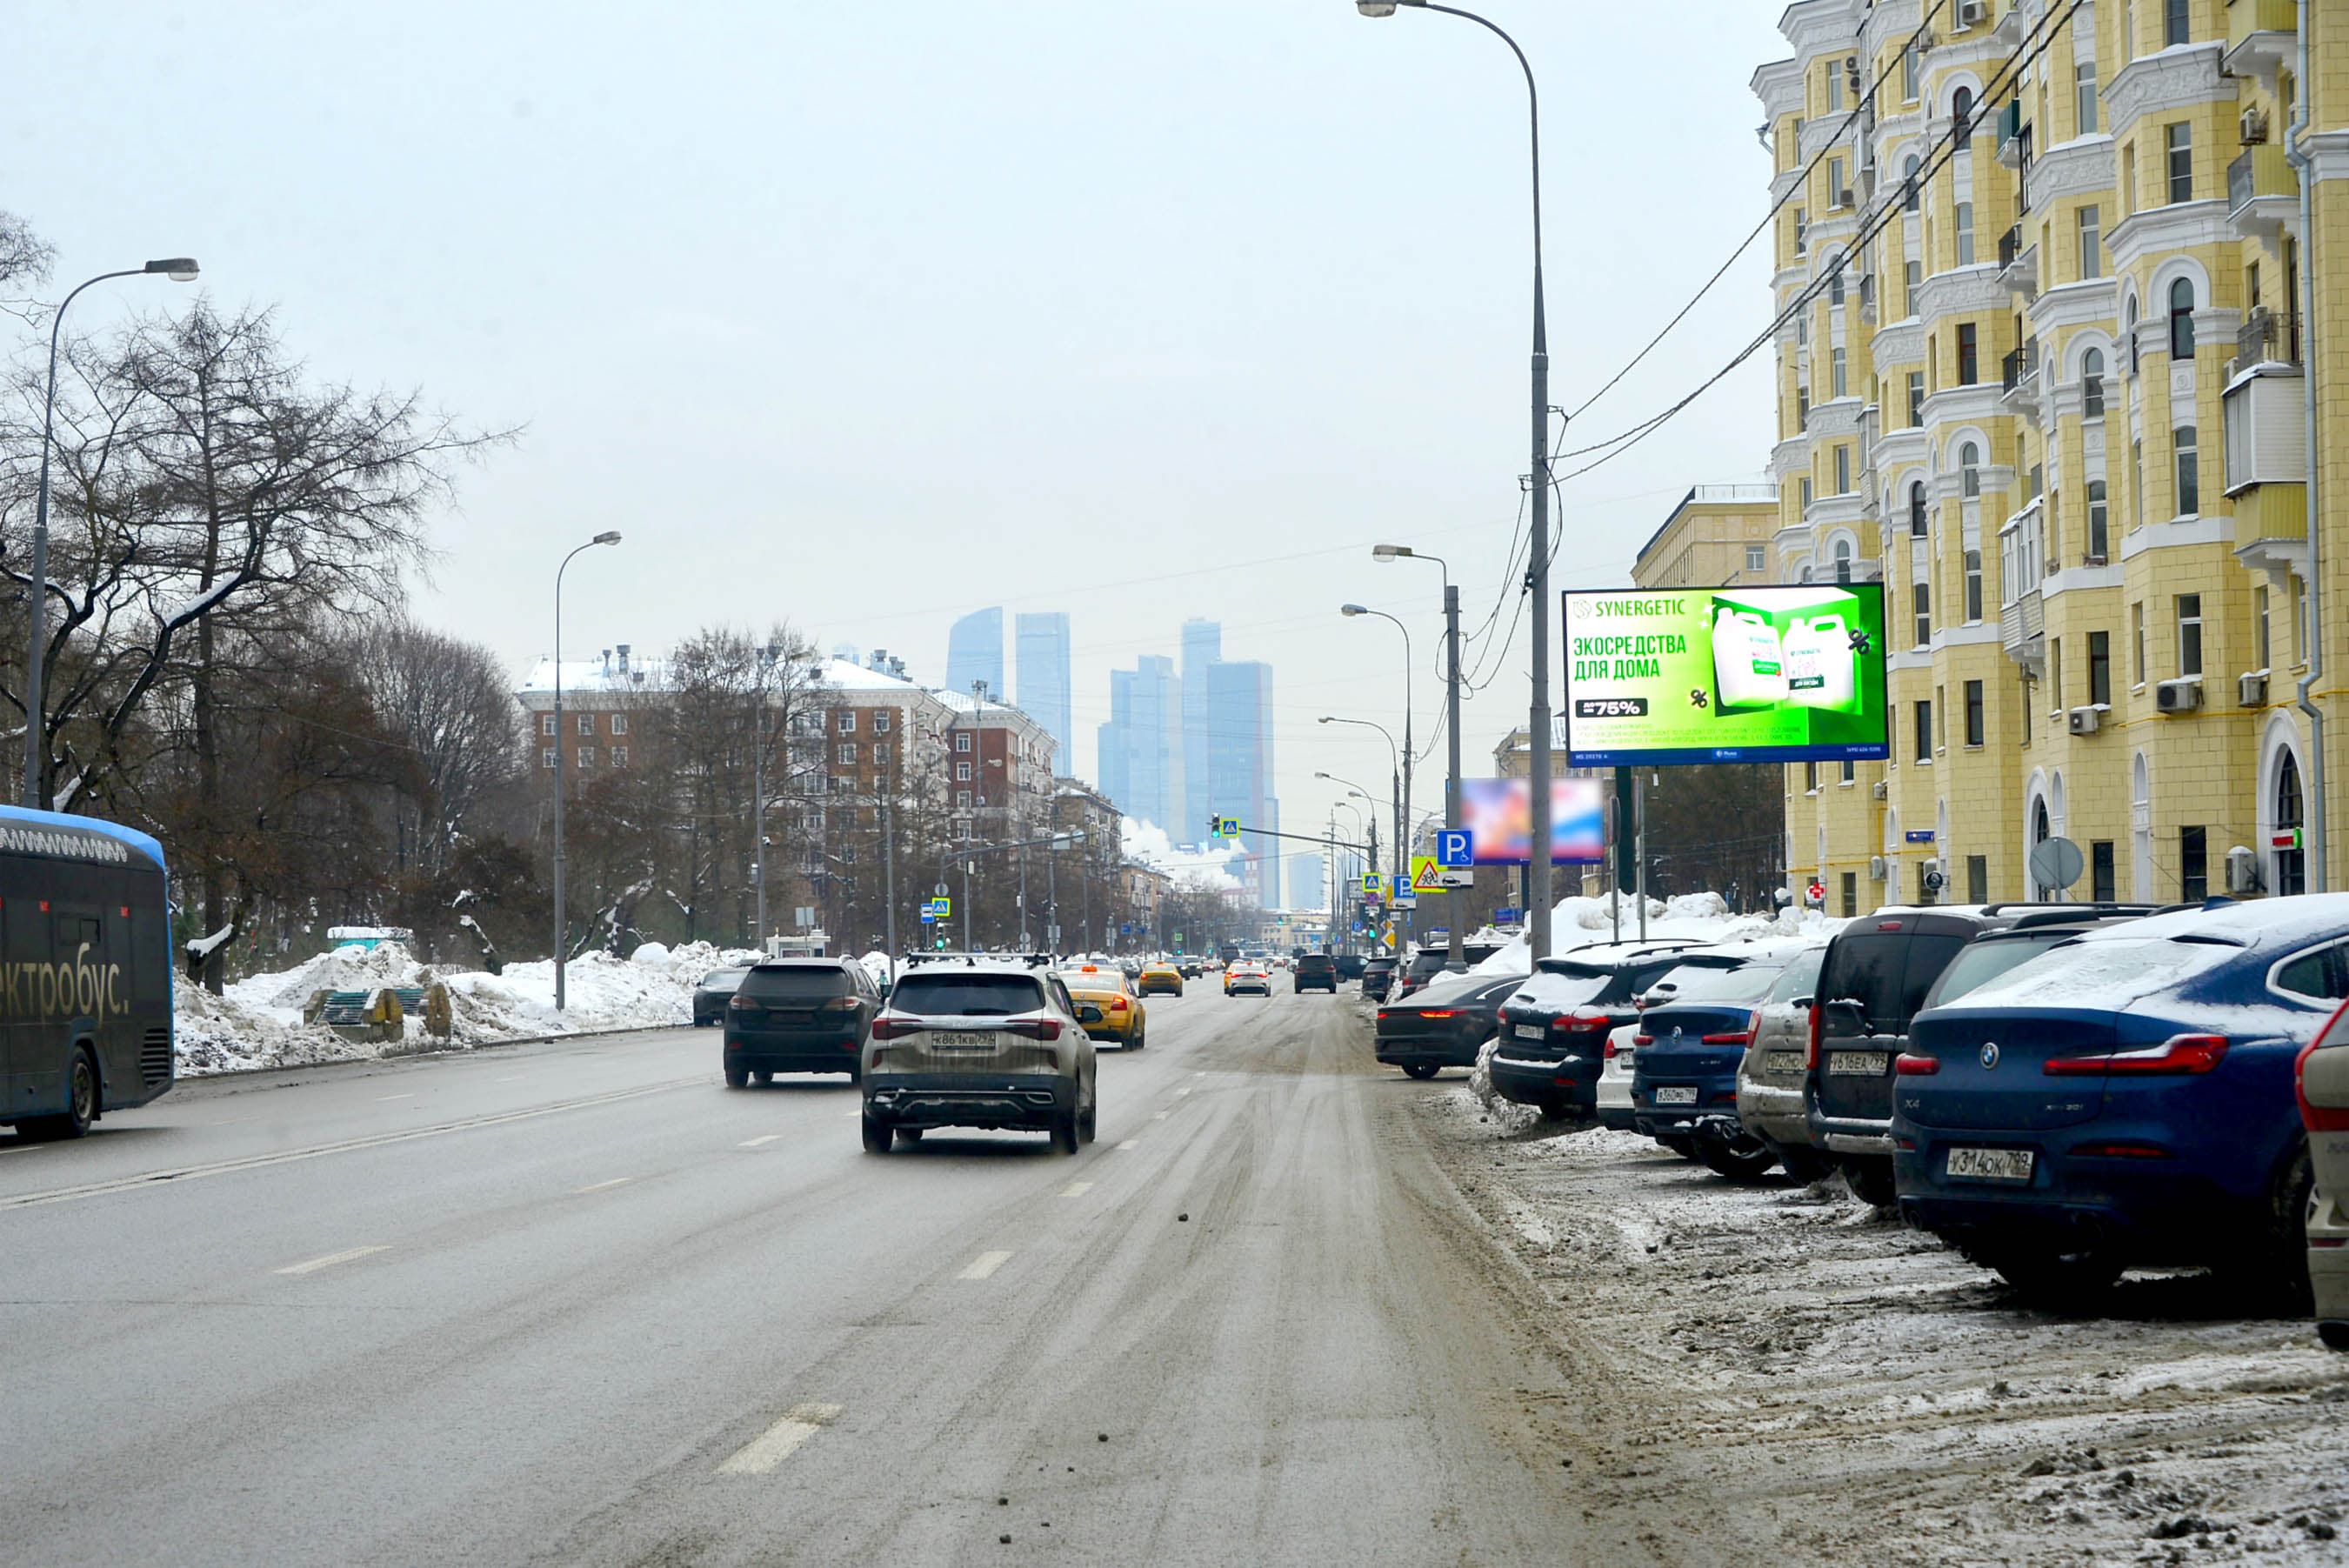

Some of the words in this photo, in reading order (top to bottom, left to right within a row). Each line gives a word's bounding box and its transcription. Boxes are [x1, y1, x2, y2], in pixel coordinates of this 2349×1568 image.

[1595, 598, 1685, 617] SYNERGETIC
[1573, 634, 1687, 657] ЭКОСРЕДСТВА
[1574, 659, 1608, 681] ДЛЯ
[1613, 658, 1661, 680] ДОМА
[1446, 833, 1466, 862] P
[0, 942, 129, 1029] ктробус.
[1905, 1098, 1920, 1109] X4
[2006, 1151, 2029, 1171] 799
